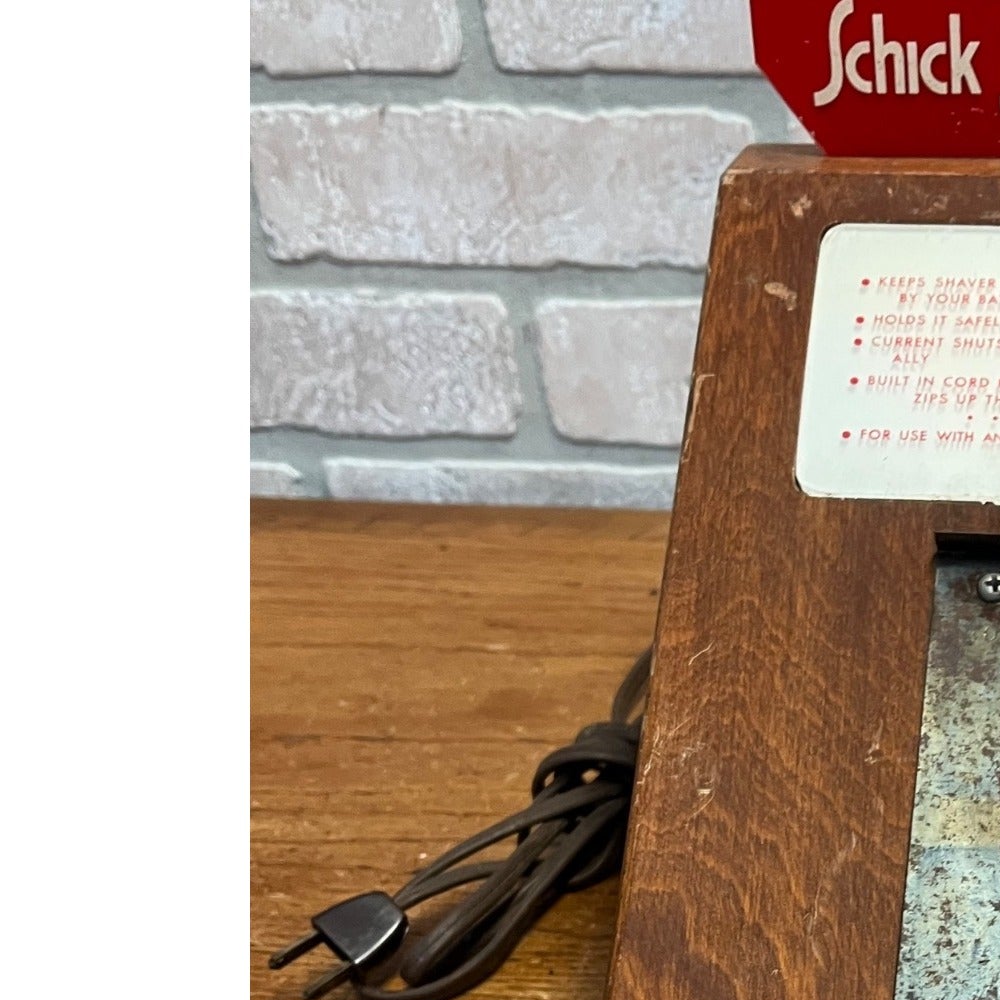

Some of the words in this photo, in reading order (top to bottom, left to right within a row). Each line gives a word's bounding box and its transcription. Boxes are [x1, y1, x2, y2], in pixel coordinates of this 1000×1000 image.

[813, 0, 982, 107] Schick
[878, 277, 926, 288] KEEPS
[935, 278, 995, 289] SHAVER
[899, 293, 918, 304] BY
[927, 293, 970, 305] YOUR
[873, 314, 926, 326] HOLDS
[933, 315, 948, 326] IT
[871, 336, 944, 348] CURRENT
[892, 353, 930, 364] ALLY
[868, 375, 910, 388] BUILT
[917, 376, 934, 387] IN
[943, 376, 990, 388] CORD
[913, 393, 949, 404] ZIPS
[956, 394, 977, 405] UP
[860, 429, 891, 441] FOR
[899, 430, 927, 441] USE
[936, 431, 974, 442] WITH
